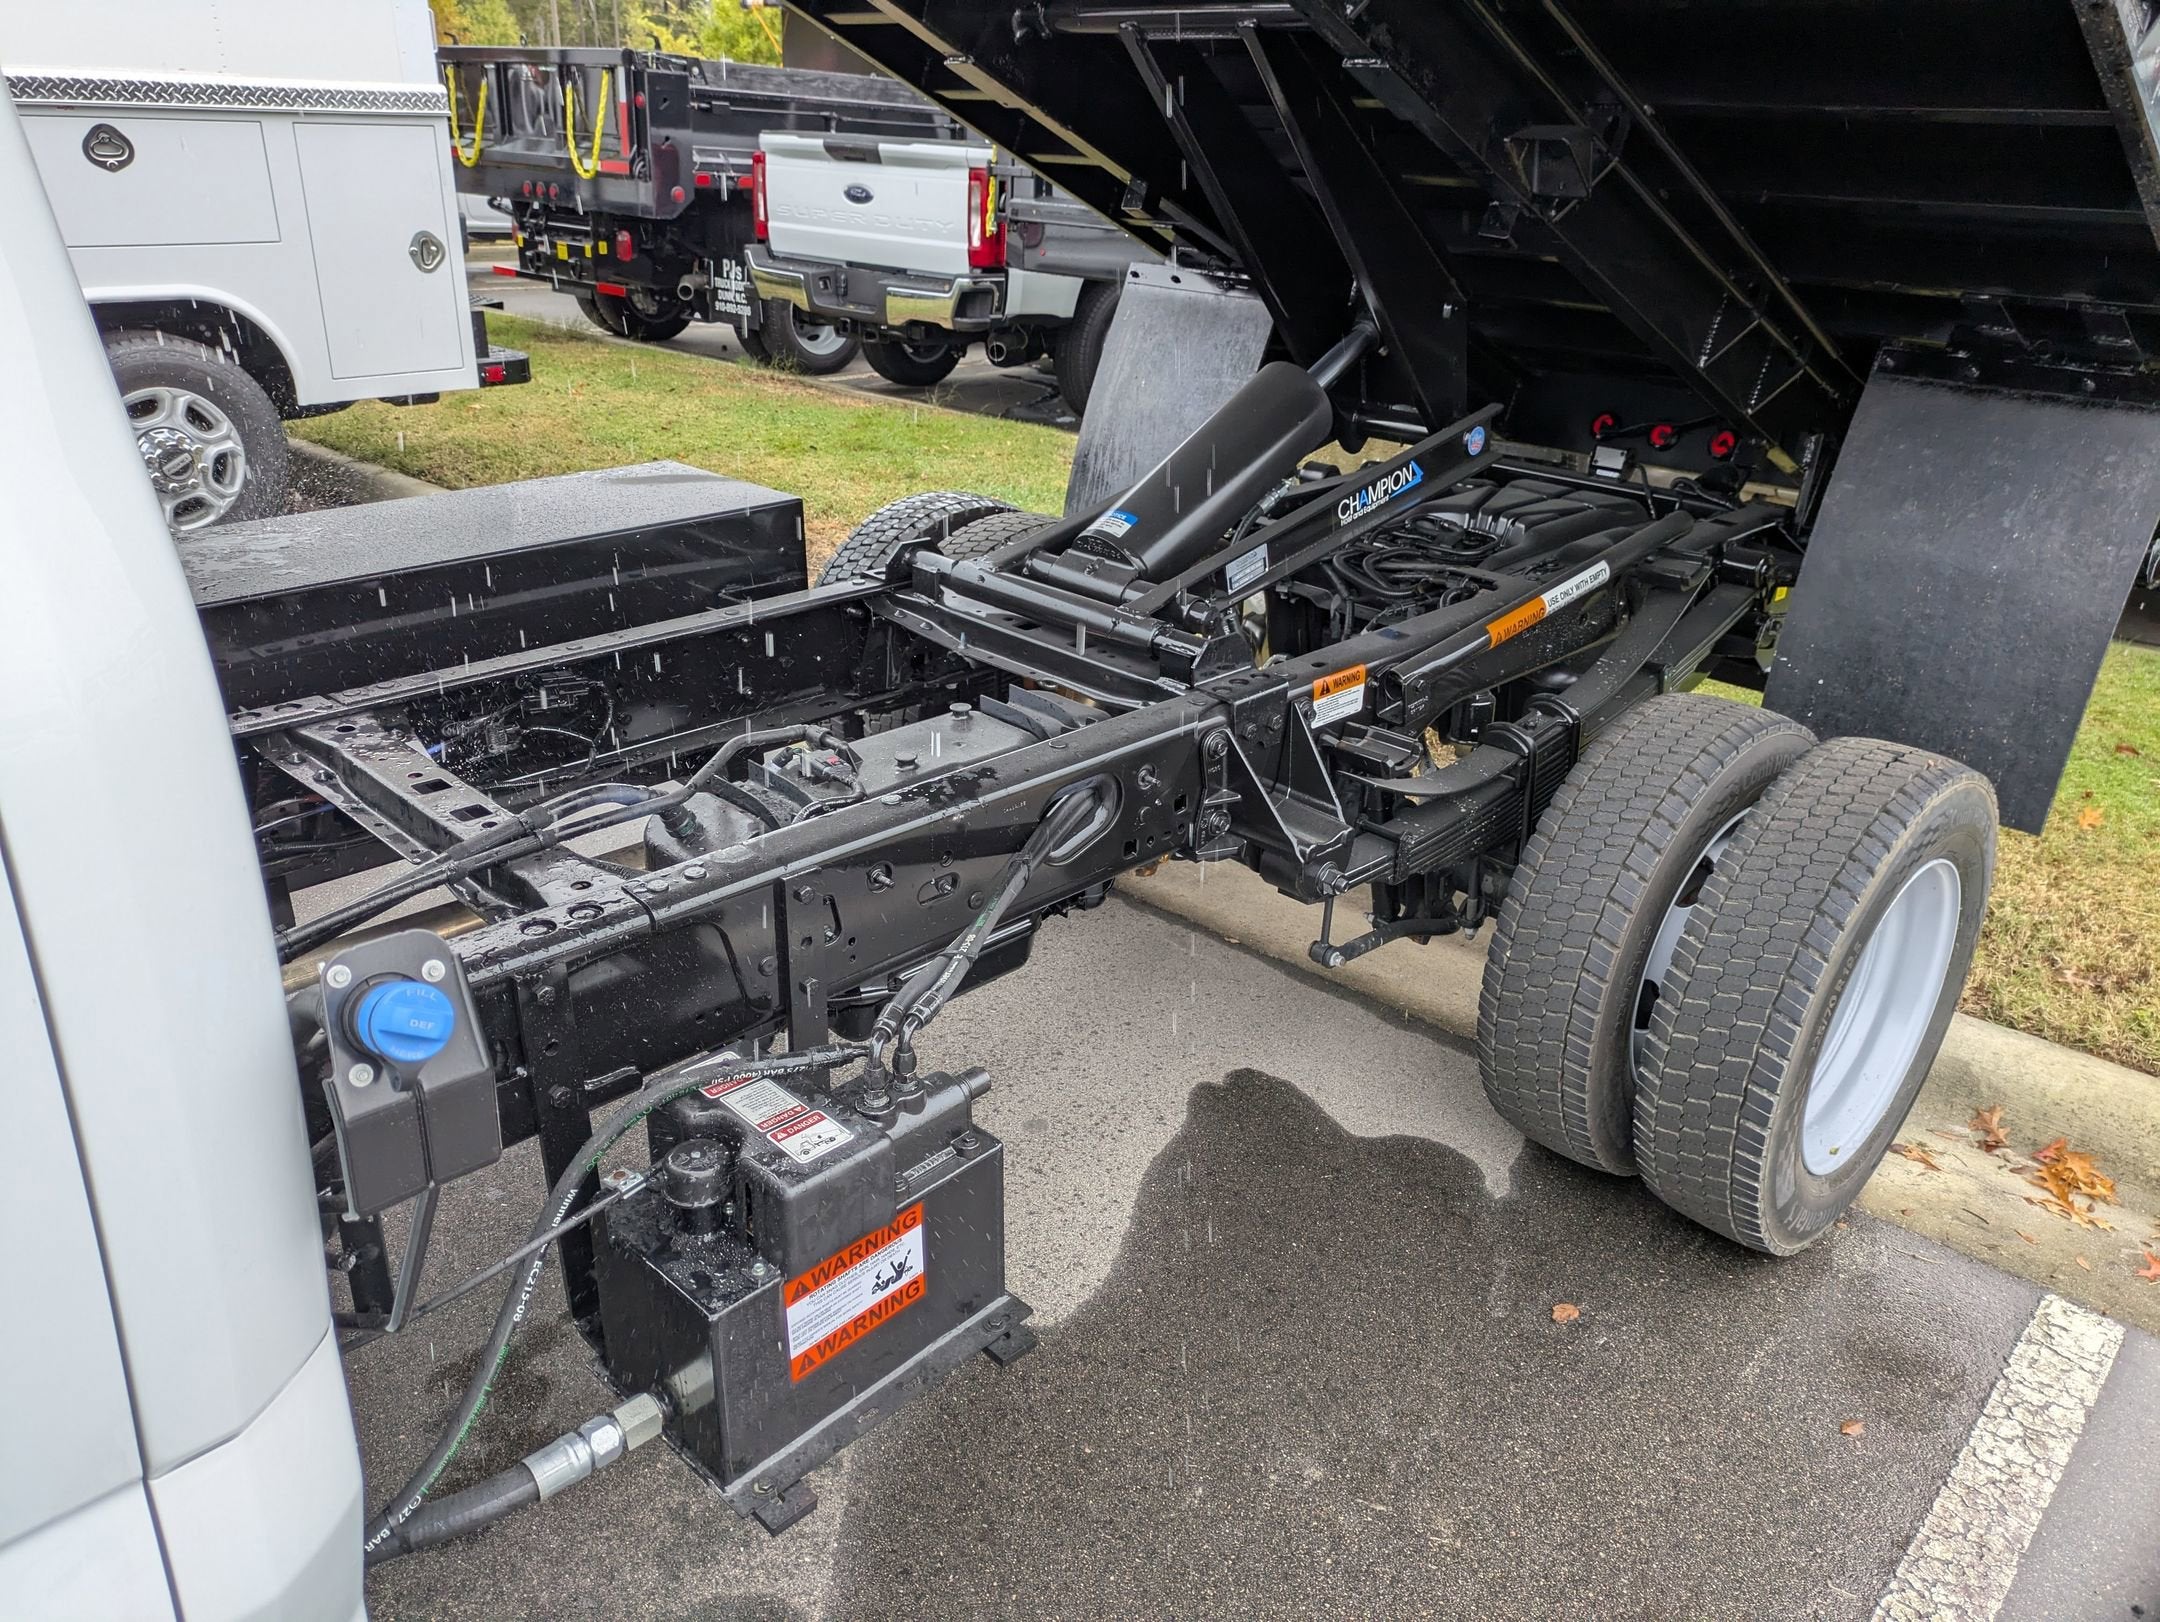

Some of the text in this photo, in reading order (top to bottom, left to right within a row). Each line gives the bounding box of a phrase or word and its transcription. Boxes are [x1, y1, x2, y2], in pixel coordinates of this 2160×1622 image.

[776, 204, 954, 234] SUPER DUTY
[1338, 463, 1414, 520] CHAMPION
[1547, 595, 1560, 608] USE
[1560, 587, 1575, 600] ONLY
[1574, 577, 1590, 591] WITH
[1589, 567, 1608, 584] EMPTY
[1503, 607, 1546, 639] WARNING
[1332, 670, 1361, 689] WARNING
[405, 988, 438, 1002] FILL
[409, 1018, 435, 1031] DEF
[760, 1110, 796, 1128] DANGER
[787, 1114, 822, 1135] DANGER
[810, 1210, 918, 1288] WARNING
[809, 1278, 835, 1299] ROTATING
[837, 1265, 856, 1281] SHAFTS
[871, 1237, 901, 1260] DANGEROUS
[512, 1260, 544, 1323] EC215-08
[816, 1279, 920, 1361] WARNING
[364, 1528, 391, 1553] BAR
